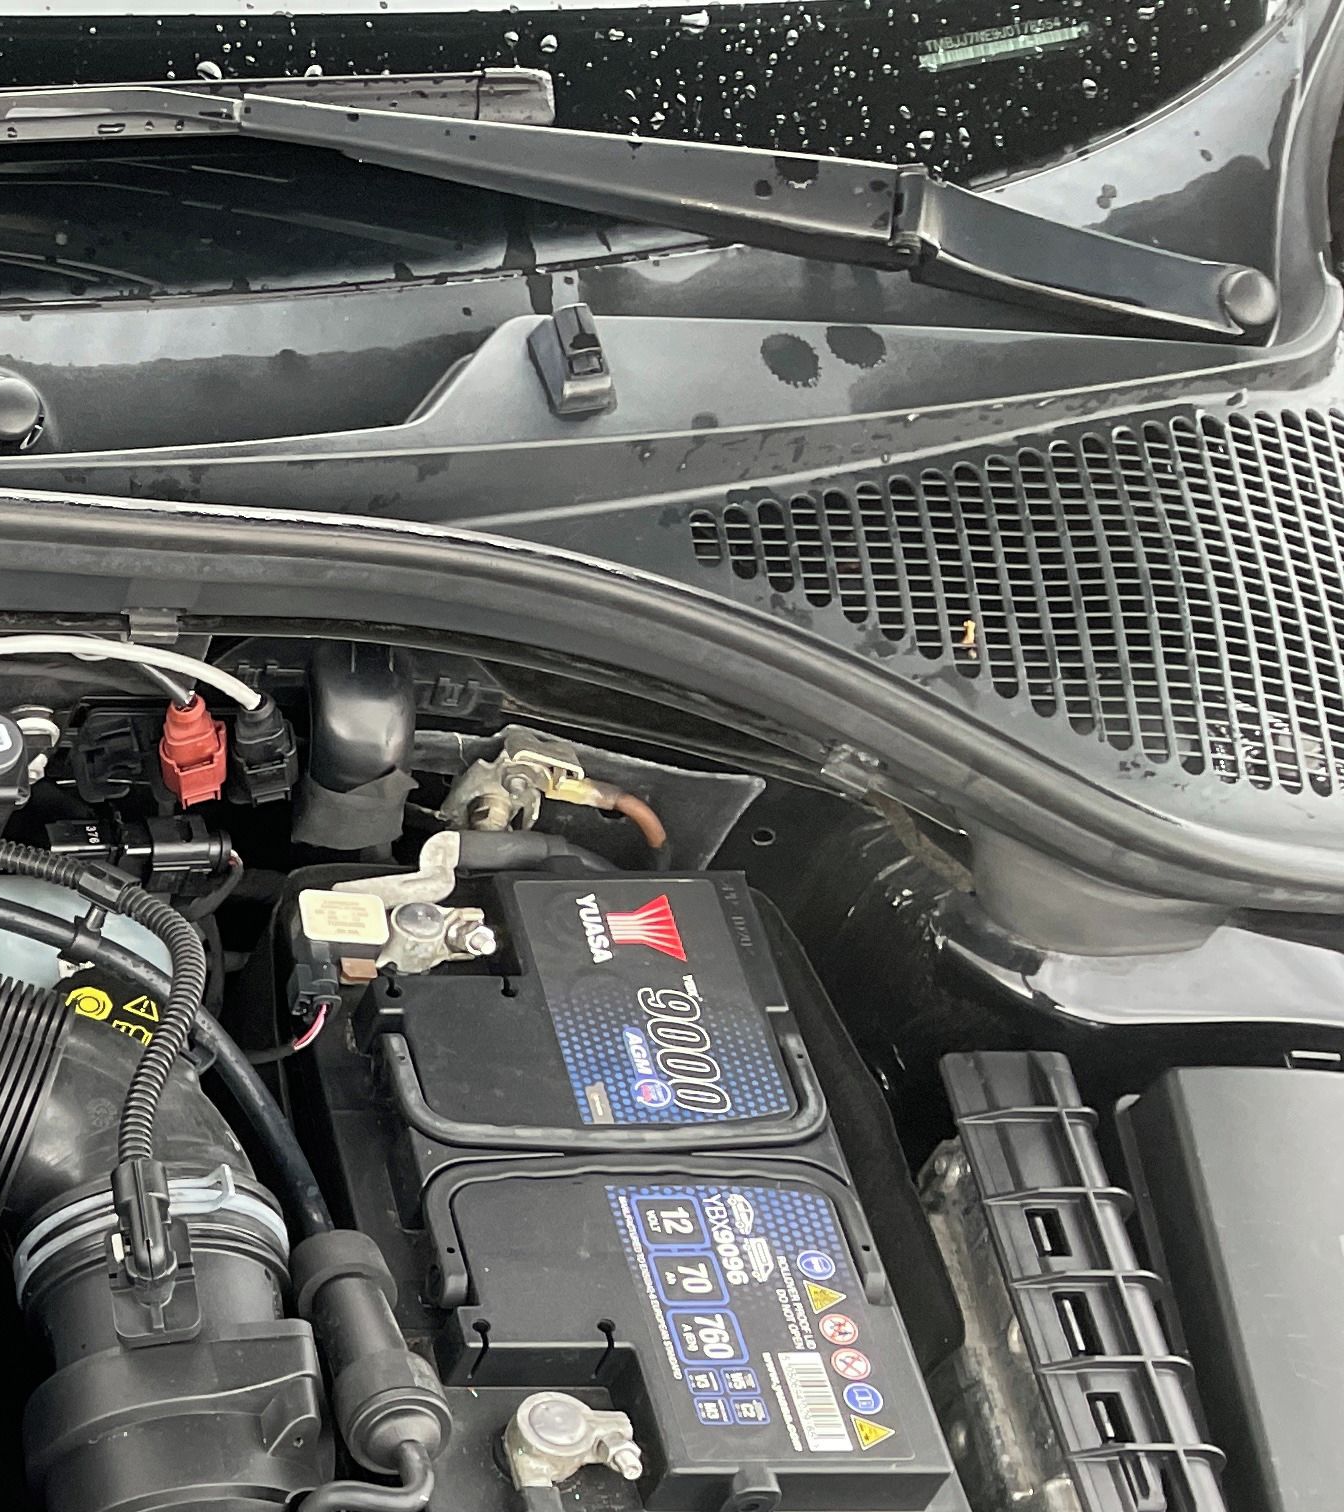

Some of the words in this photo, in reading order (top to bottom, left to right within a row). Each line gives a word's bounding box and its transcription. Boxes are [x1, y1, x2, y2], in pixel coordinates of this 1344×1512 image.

[575, 893, 613, 963] YUASA
[625, 1031, 653, 1074] AGM
[637, 987, 732, 1114] 9000
[646, 1209, 660, 1233] VOLT
[660, 1206, 694, 1235] 12
[702, 1193, 749, 1285] YBX9096
[678, 1262, 713, 1294] 70
[776, 1255, 801, 1302] ROLLOVER
[775, 1289, 788, 1303] DO
[780, 1303, 796, 1323] NOT
[786, 1302, 811, 1334] PROOF
[694, 1314, 735, 1360] 760
[784, 1324, 803, 1350] OPEN
